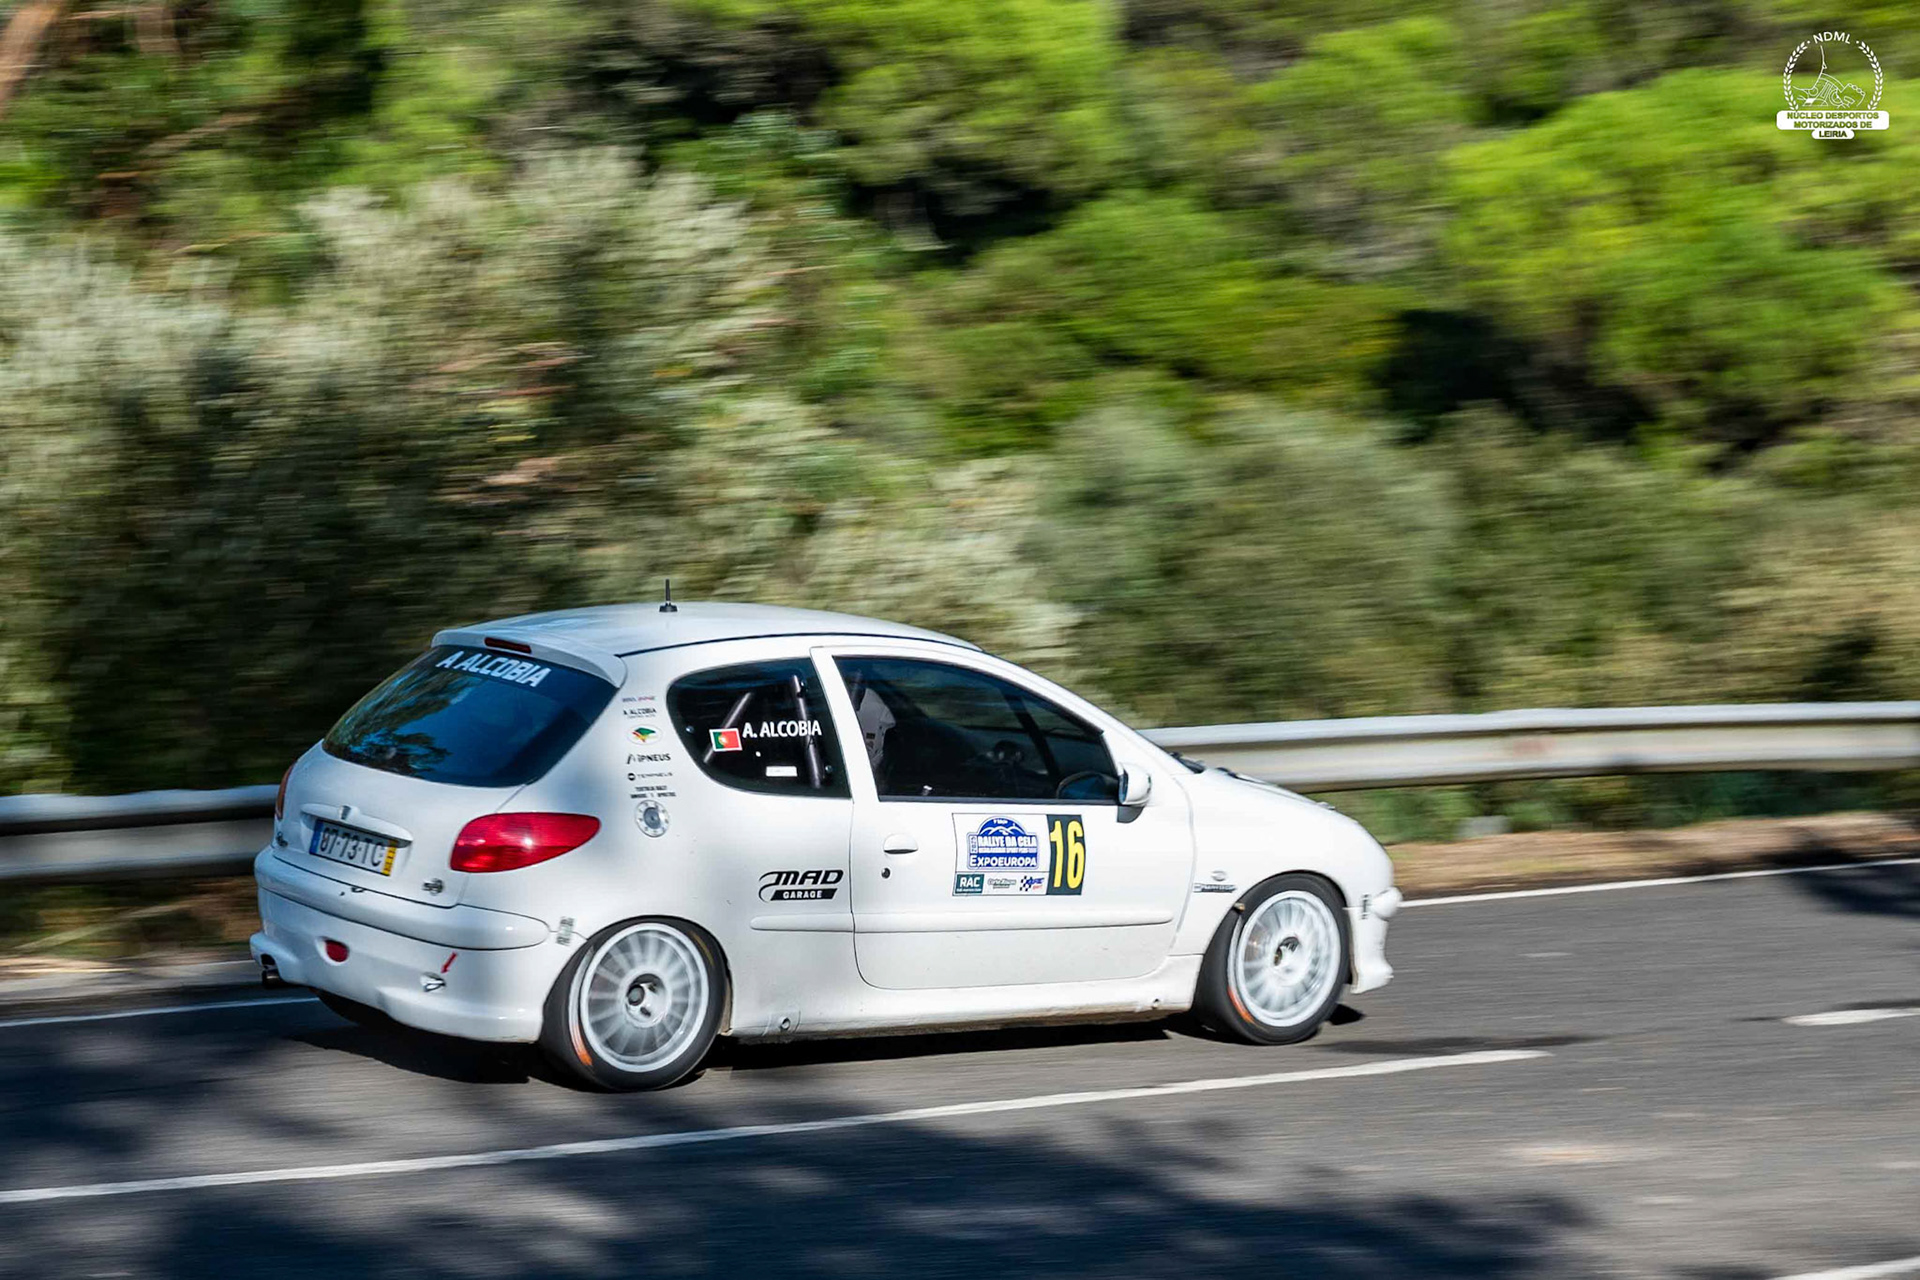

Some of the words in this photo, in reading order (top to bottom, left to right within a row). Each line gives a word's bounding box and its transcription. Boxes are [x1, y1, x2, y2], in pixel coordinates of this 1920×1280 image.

[453, 653, 552, 687] ALCOBIA
[742, 722, 757, 738] A.
[760, 720, 822, 737] ALCOBIA
[320, 827, 384, 867] 87-73-TC
[977, 835, 1005, 848] RALLYE
[1005, 836, 1018, 848] DA
[1018, 836, 1037, 848] CELA
[1050, 820, 1085, 889] 16
[759, 869, 844, 889] MAD
[960, 877, 980, 887] RAC
[783, 890, 822, 899] GARAGE
